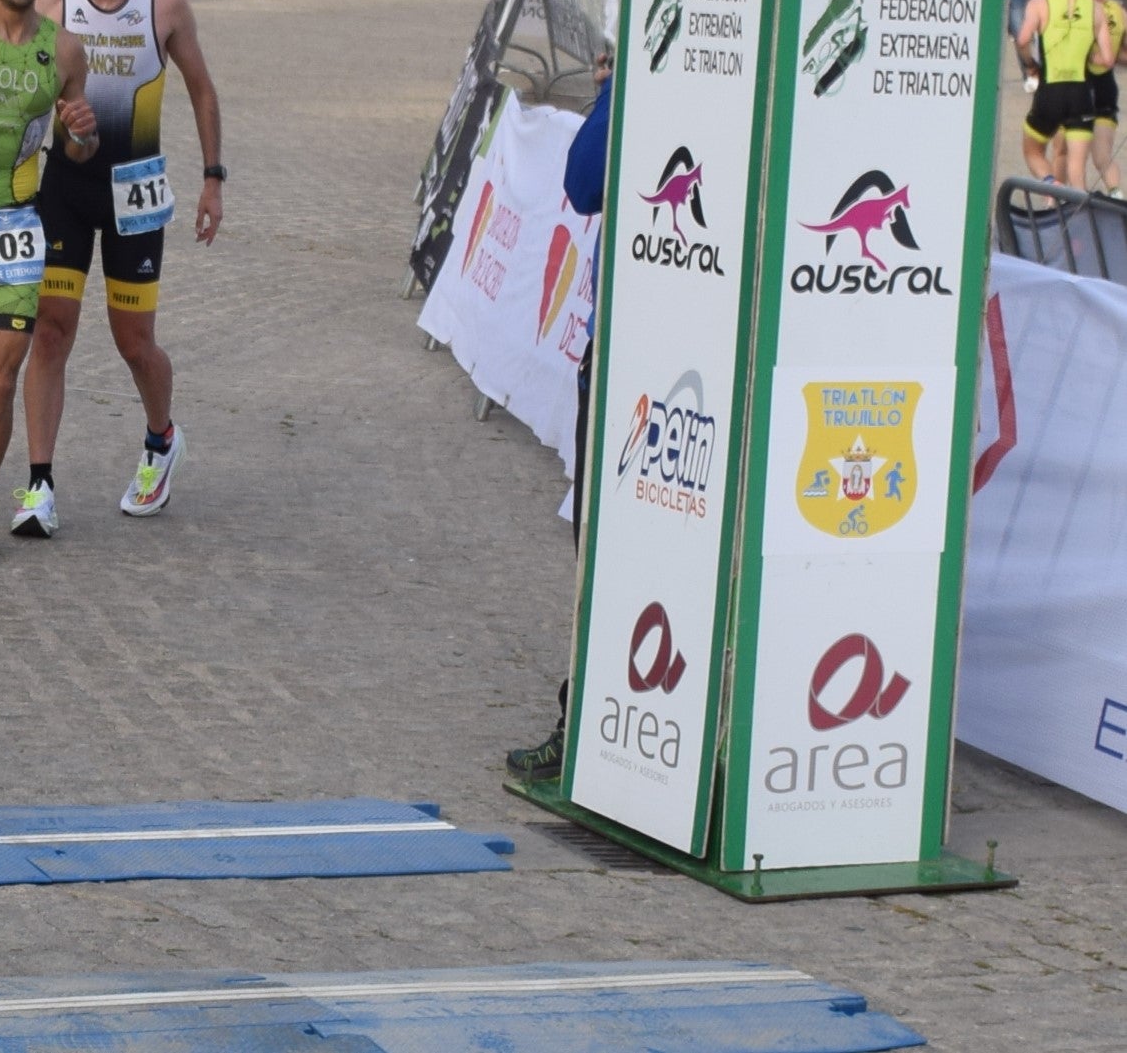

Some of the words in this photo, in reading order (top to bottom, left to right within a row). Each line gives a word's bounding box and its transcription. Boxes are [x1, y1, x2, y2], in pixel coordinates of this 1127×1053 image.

[688, 11, 743, 40] EXTREMEÑA
[684, 49, 697, 72] DE
[879, 33, 970, 60] EXTREMEÑA
[873, 70, 894, 95] DE
[632, 234, 726, 277] austral
[790, 264, 954, 296] austral
[822, 384, 906, 407] TRIATLÓN
[823, 409, 902, 427] TRUJILLO
[636, 479, 706, 519] BICICLETAS
[600, 696, 681, 769] area
[764, 742, 909, 794] area
[767, 800, 826, 813] ABOGADOS
[830, 800, 837, 809] Y
[841, 797, 893, 810] ASESORES
